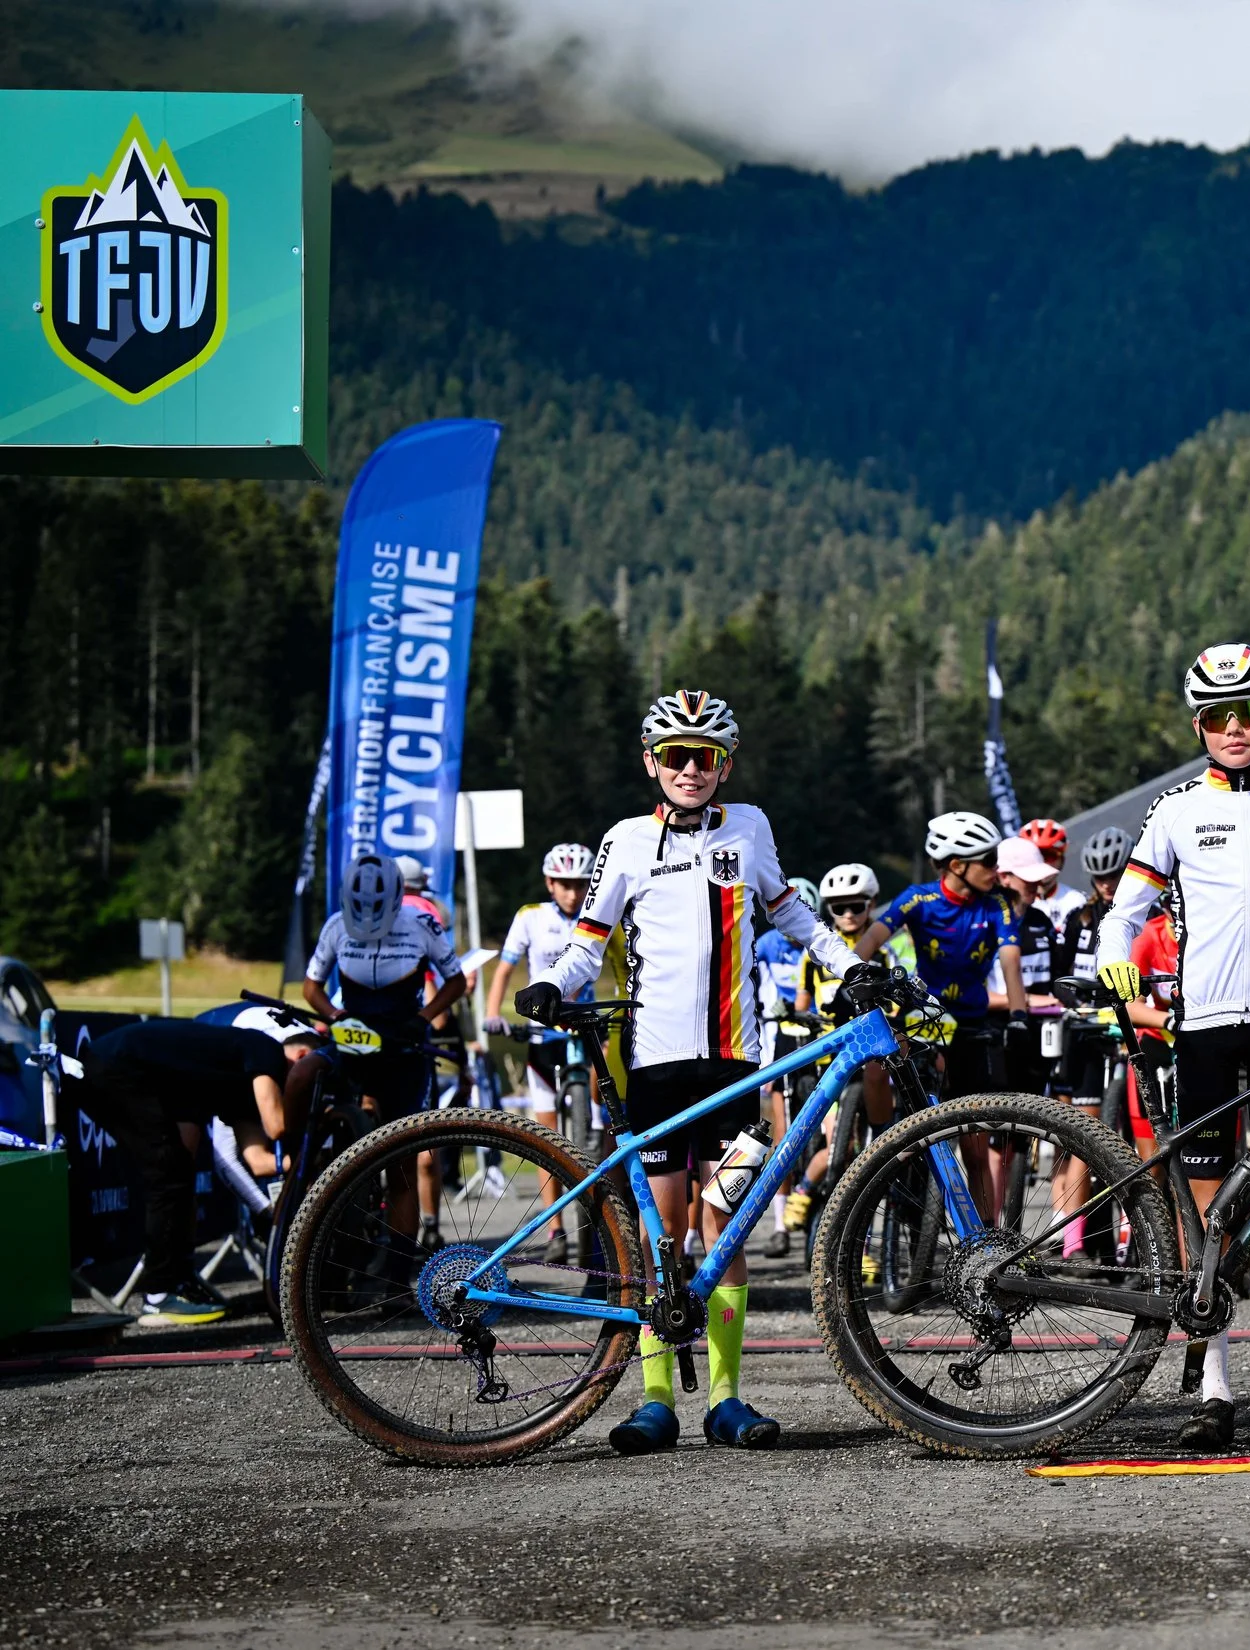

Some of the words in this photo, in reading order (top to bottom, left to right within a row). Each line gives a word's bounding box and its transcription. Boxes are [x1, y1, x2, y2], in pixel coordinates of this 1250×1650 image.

[59, 230, 211, 334] TFJV
[360, 541, 402, 714] FRANÇAISE
[381, 546, 461, 851] CYCLISME
[347, 719, 385, 860] DÉRATION
[1198, 836, 1227, 847] KTM
[344, 1028, 371, 1045] 337
